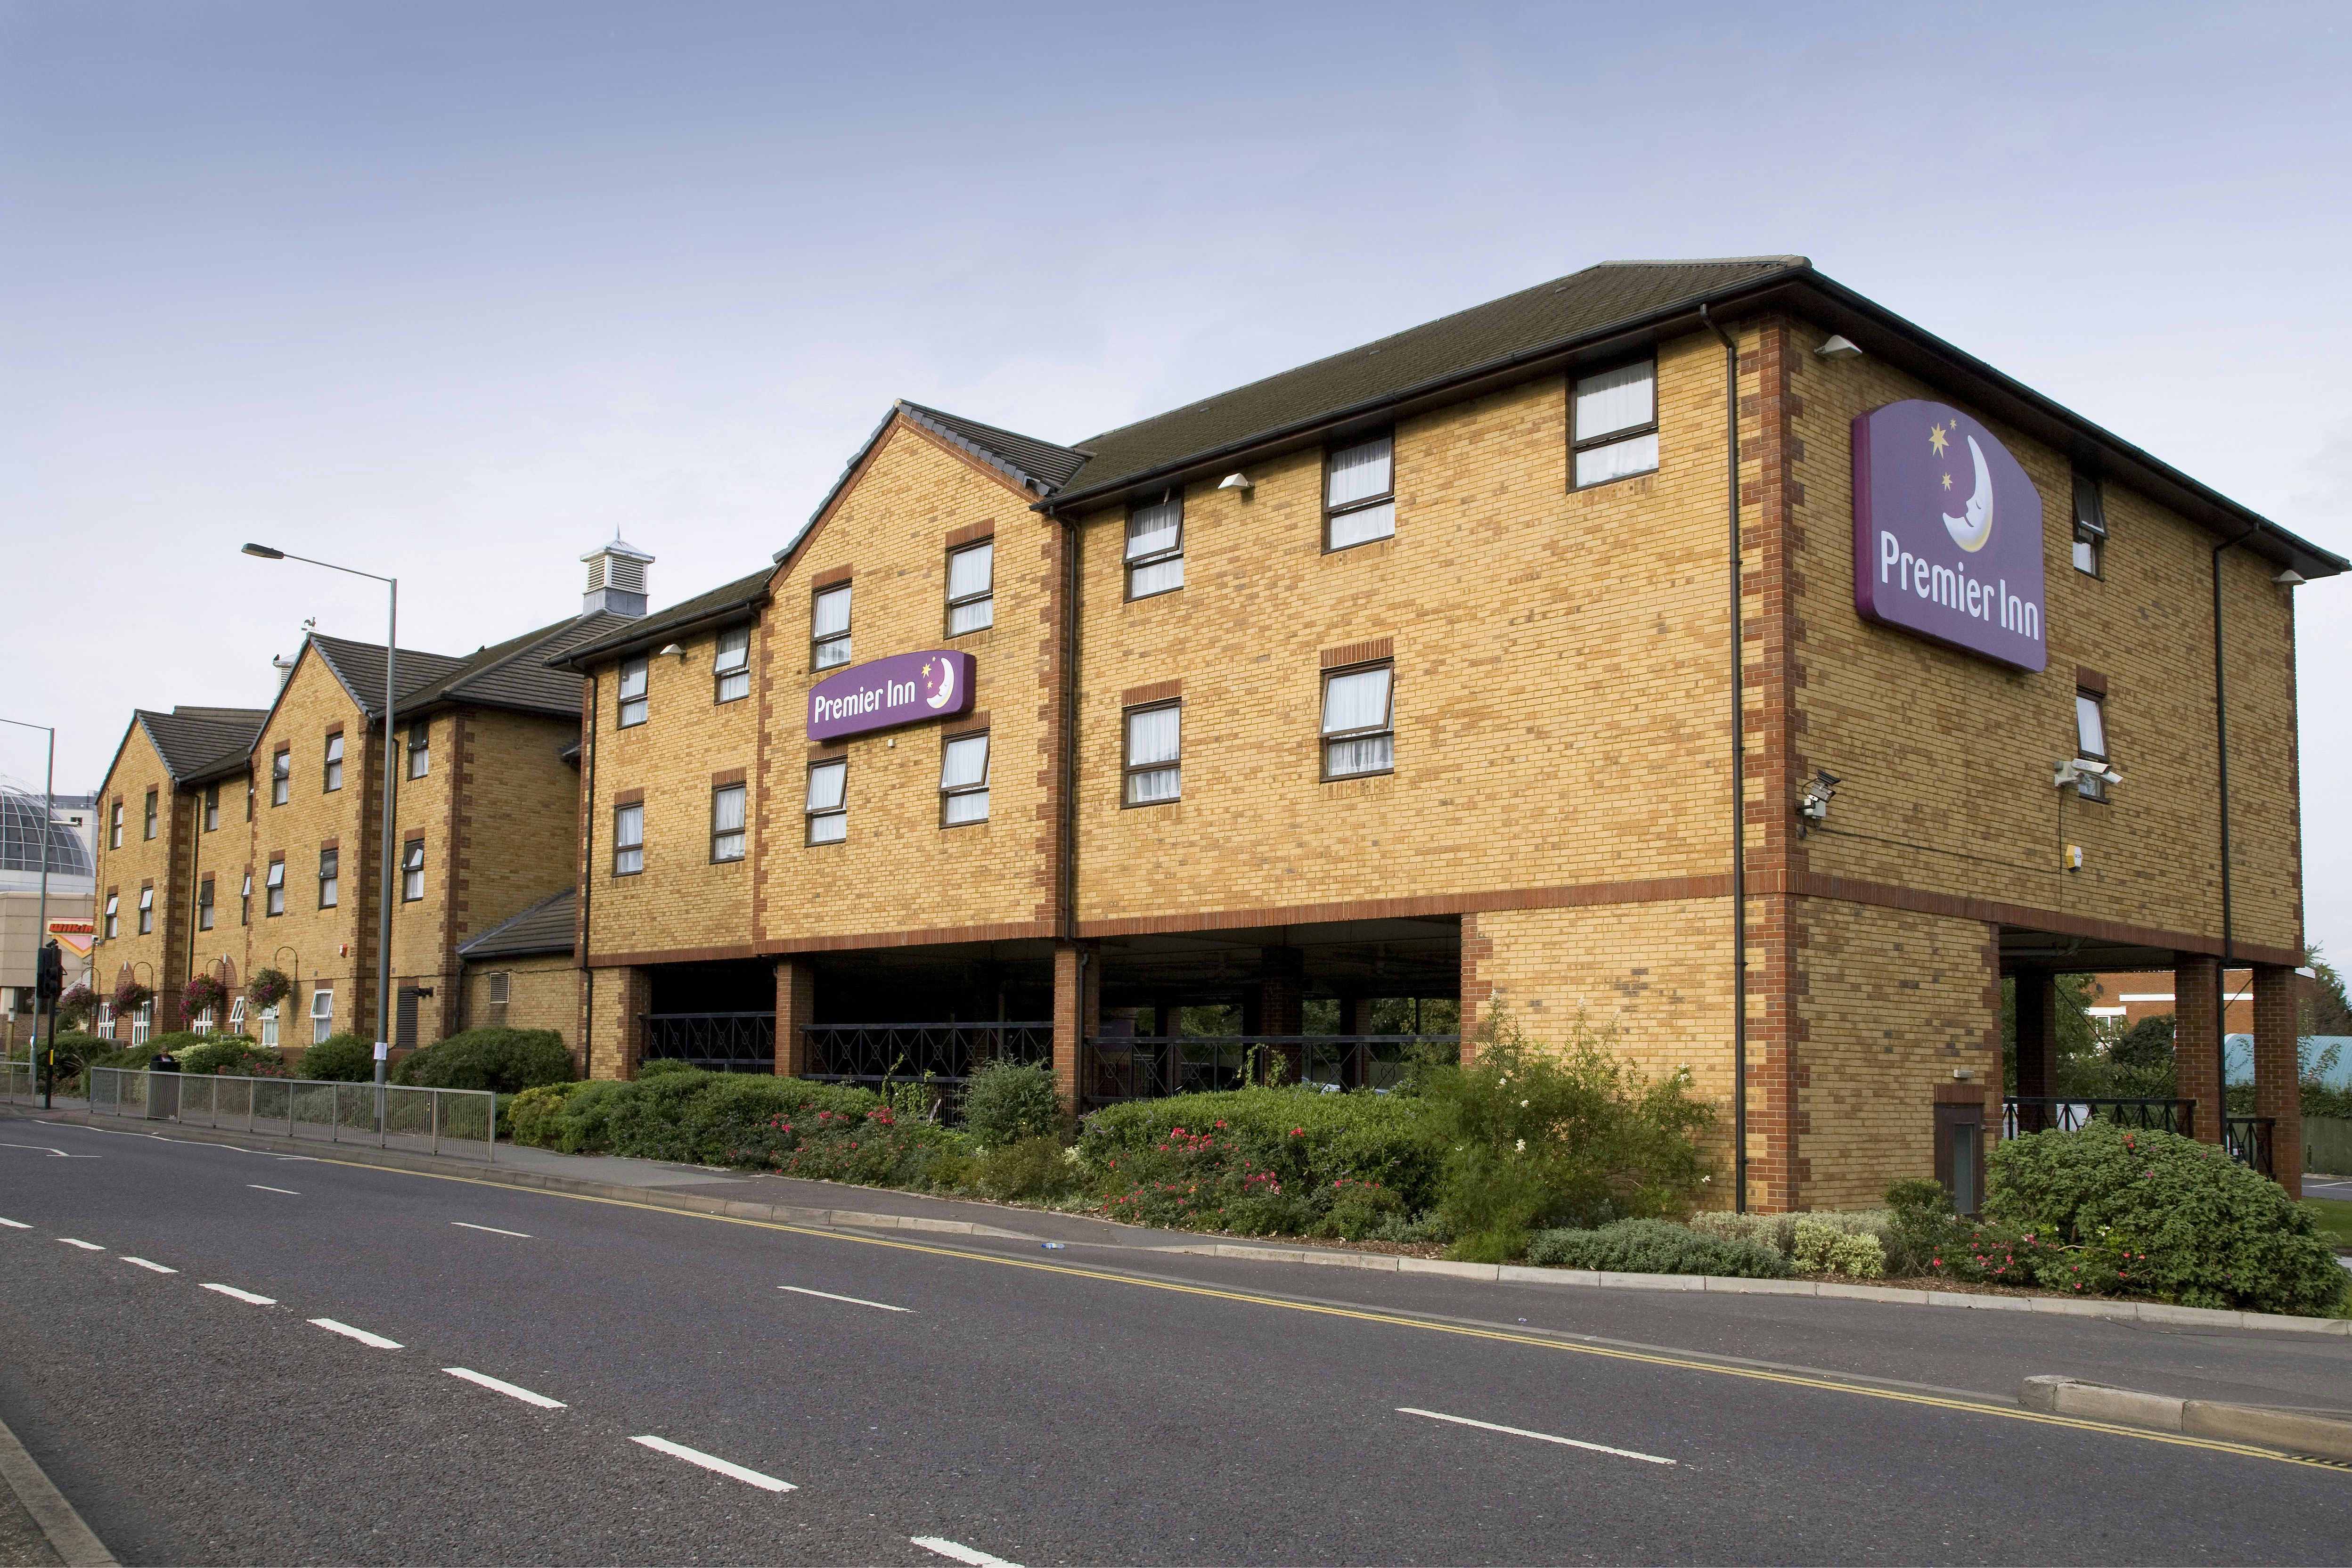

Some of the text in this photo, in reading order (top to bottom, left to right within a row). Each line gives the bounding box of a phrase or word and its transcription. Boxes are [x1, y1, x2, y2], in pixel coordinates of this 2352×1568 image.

[1881, 531, 2039, 640] Premier Inn
[814, 679, 915, 723] Premier Inn
